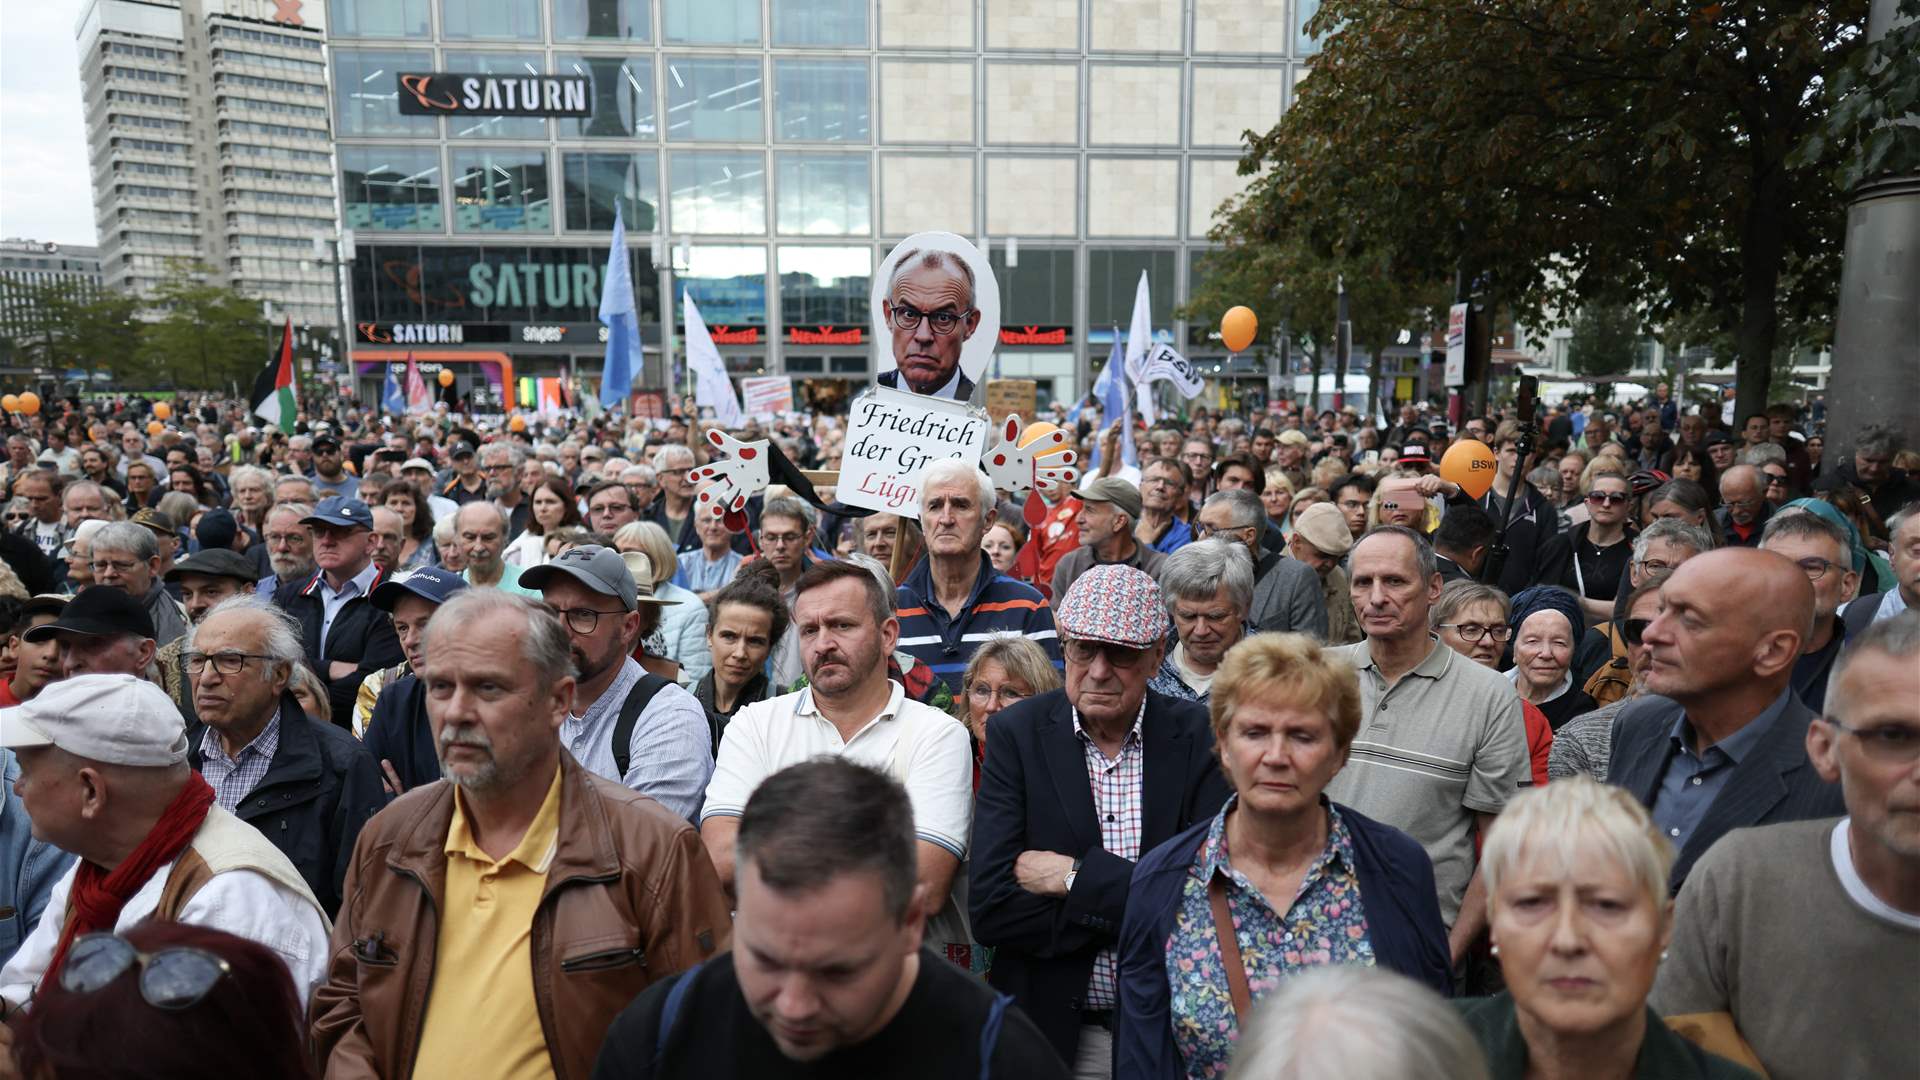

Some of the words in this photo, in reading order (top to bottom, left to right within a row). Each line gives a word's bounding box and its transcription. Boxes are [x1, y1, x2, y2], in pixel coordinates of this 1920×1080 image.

[462, 77, 586, 111] SATURN
[469, 262, 610, 308] SATUR
[393, 323, 464, 343] SATURN
[857, 403, 976, 446] Friedrich
[851, 433, 892, 461] der
[1472, 459, 1495, 470] BSW
